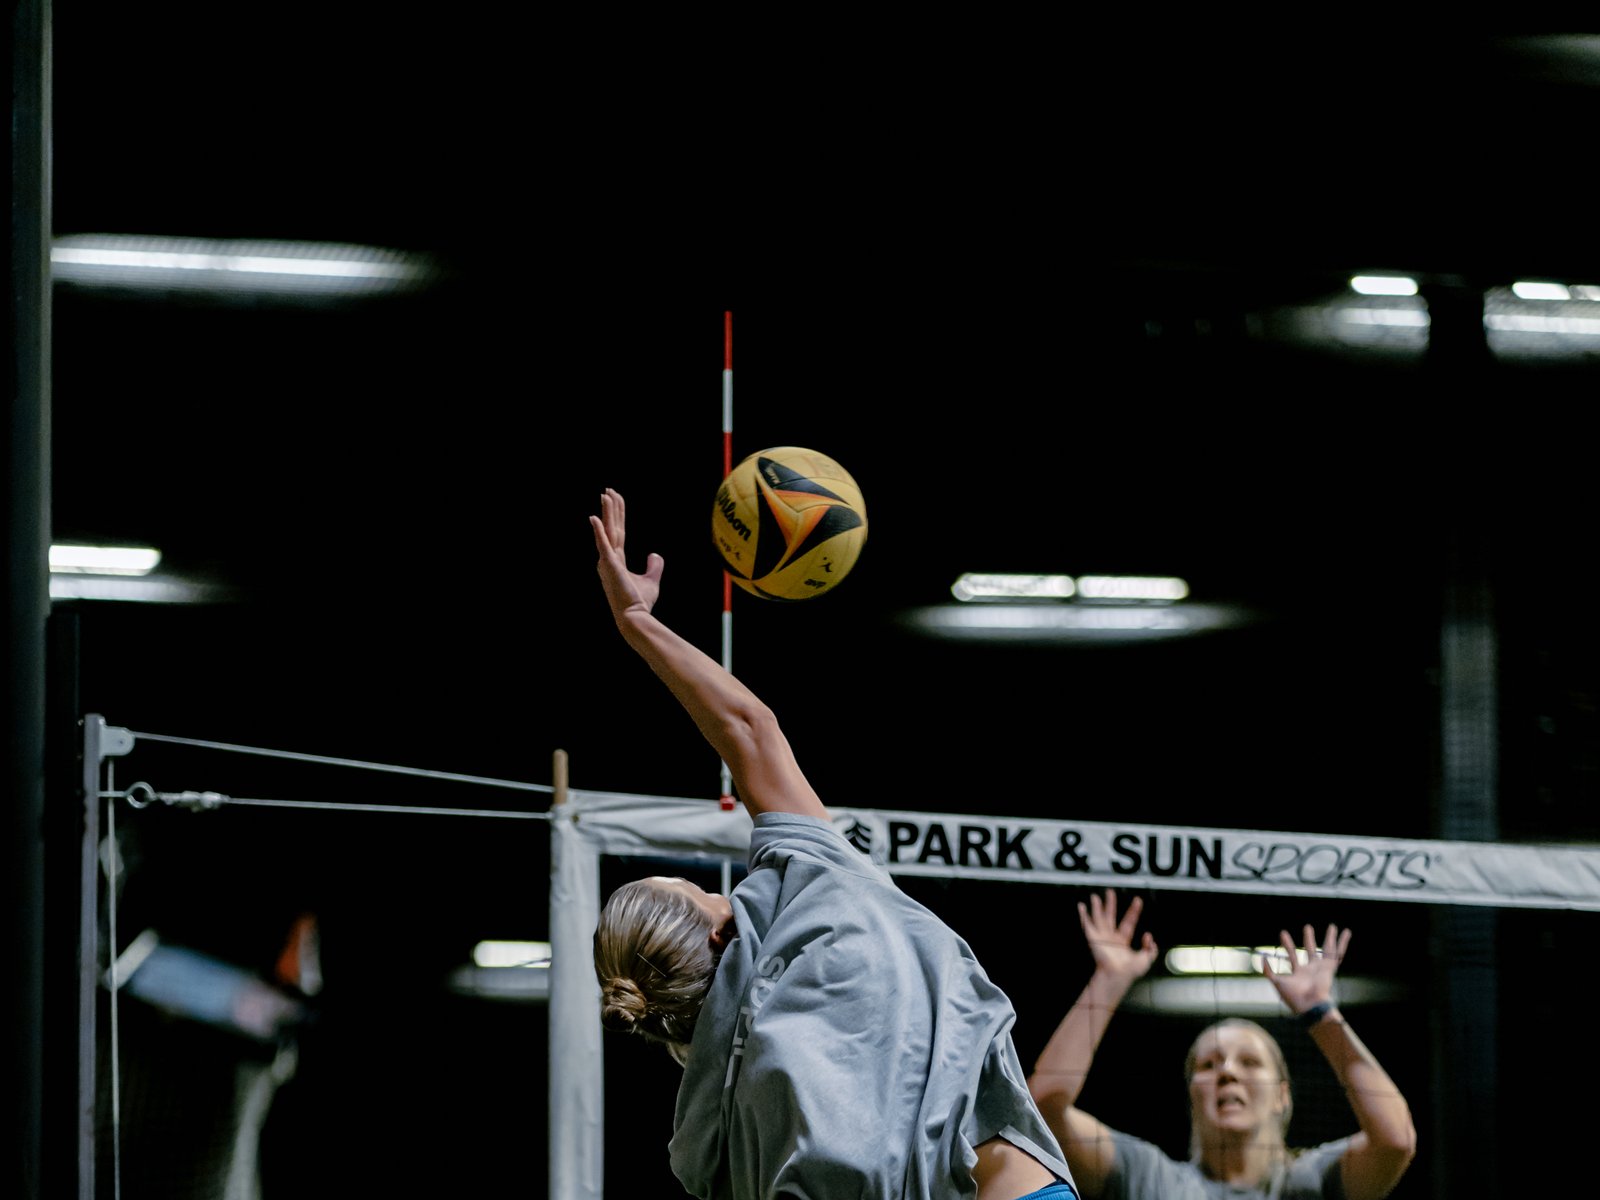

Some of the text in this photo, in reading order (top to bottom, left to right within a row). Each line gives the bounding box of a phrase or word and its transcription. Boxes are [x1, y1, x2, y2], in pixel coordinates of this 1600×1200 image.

[888, 821, 1431, 890] PARK & SUN SPORTS
